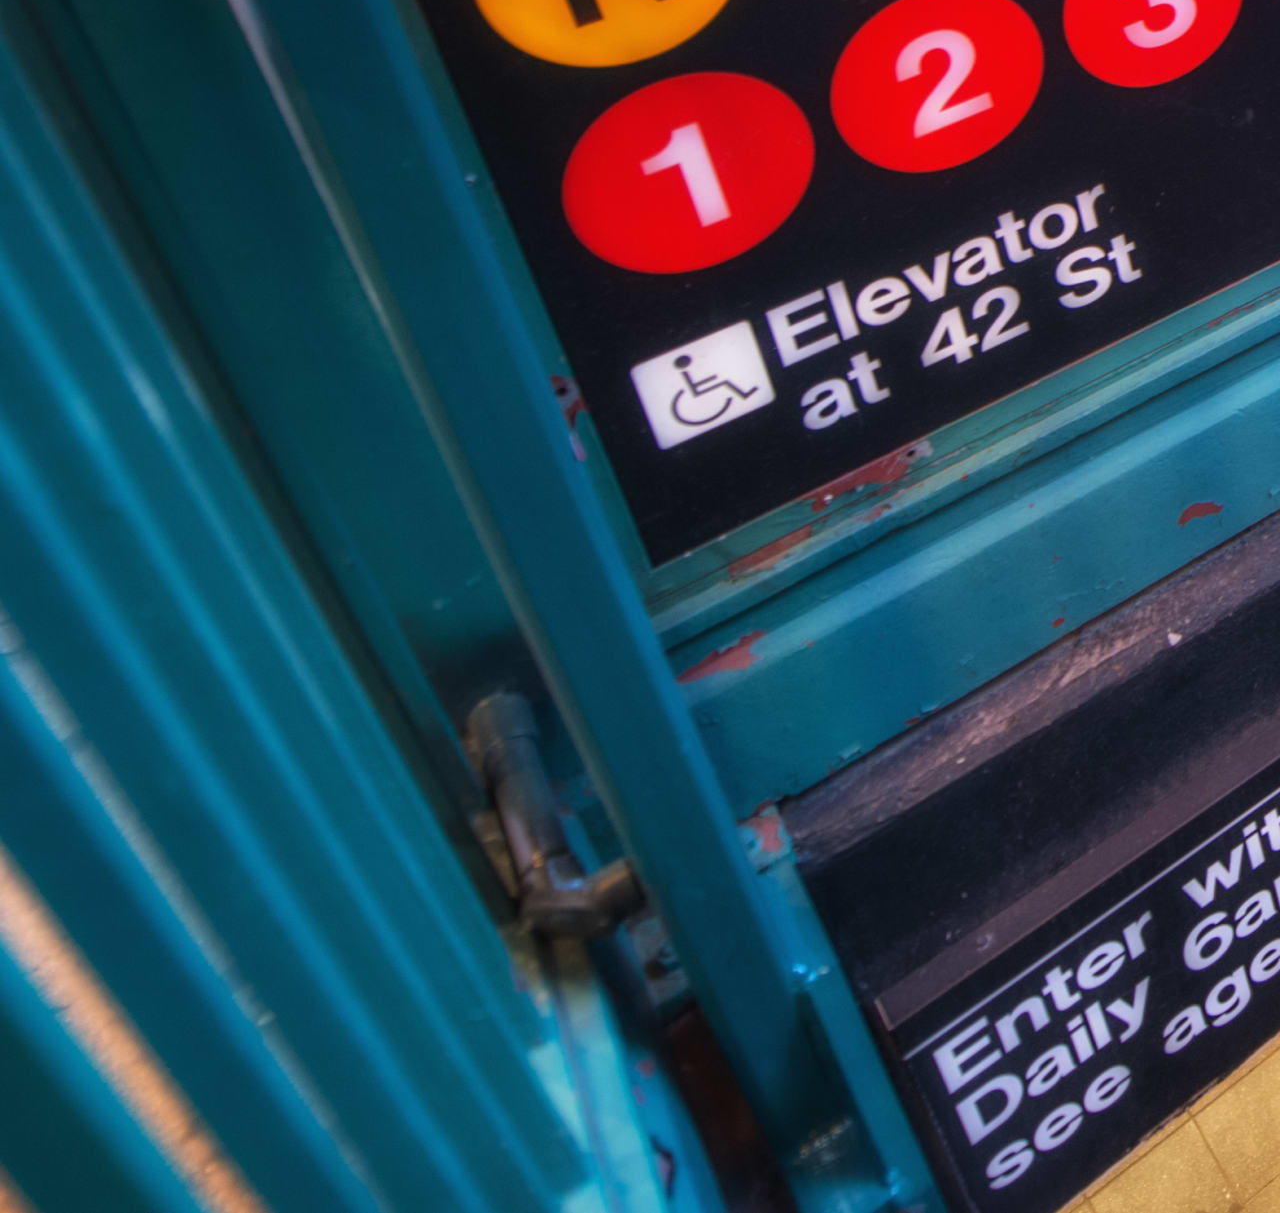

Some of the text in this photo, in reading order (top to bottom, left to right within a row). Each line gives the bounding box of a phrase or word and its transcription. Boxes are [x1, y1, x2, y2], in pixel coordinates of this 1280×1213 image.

[765, 183, 1106, 368] Elevator
[800, 233, 1143, 432] at 42 St
[931, 910, 1153, 1096] Enter
[956, 975, 1151, 1147] Daily
[985, 1063, 1132, 1190] see
